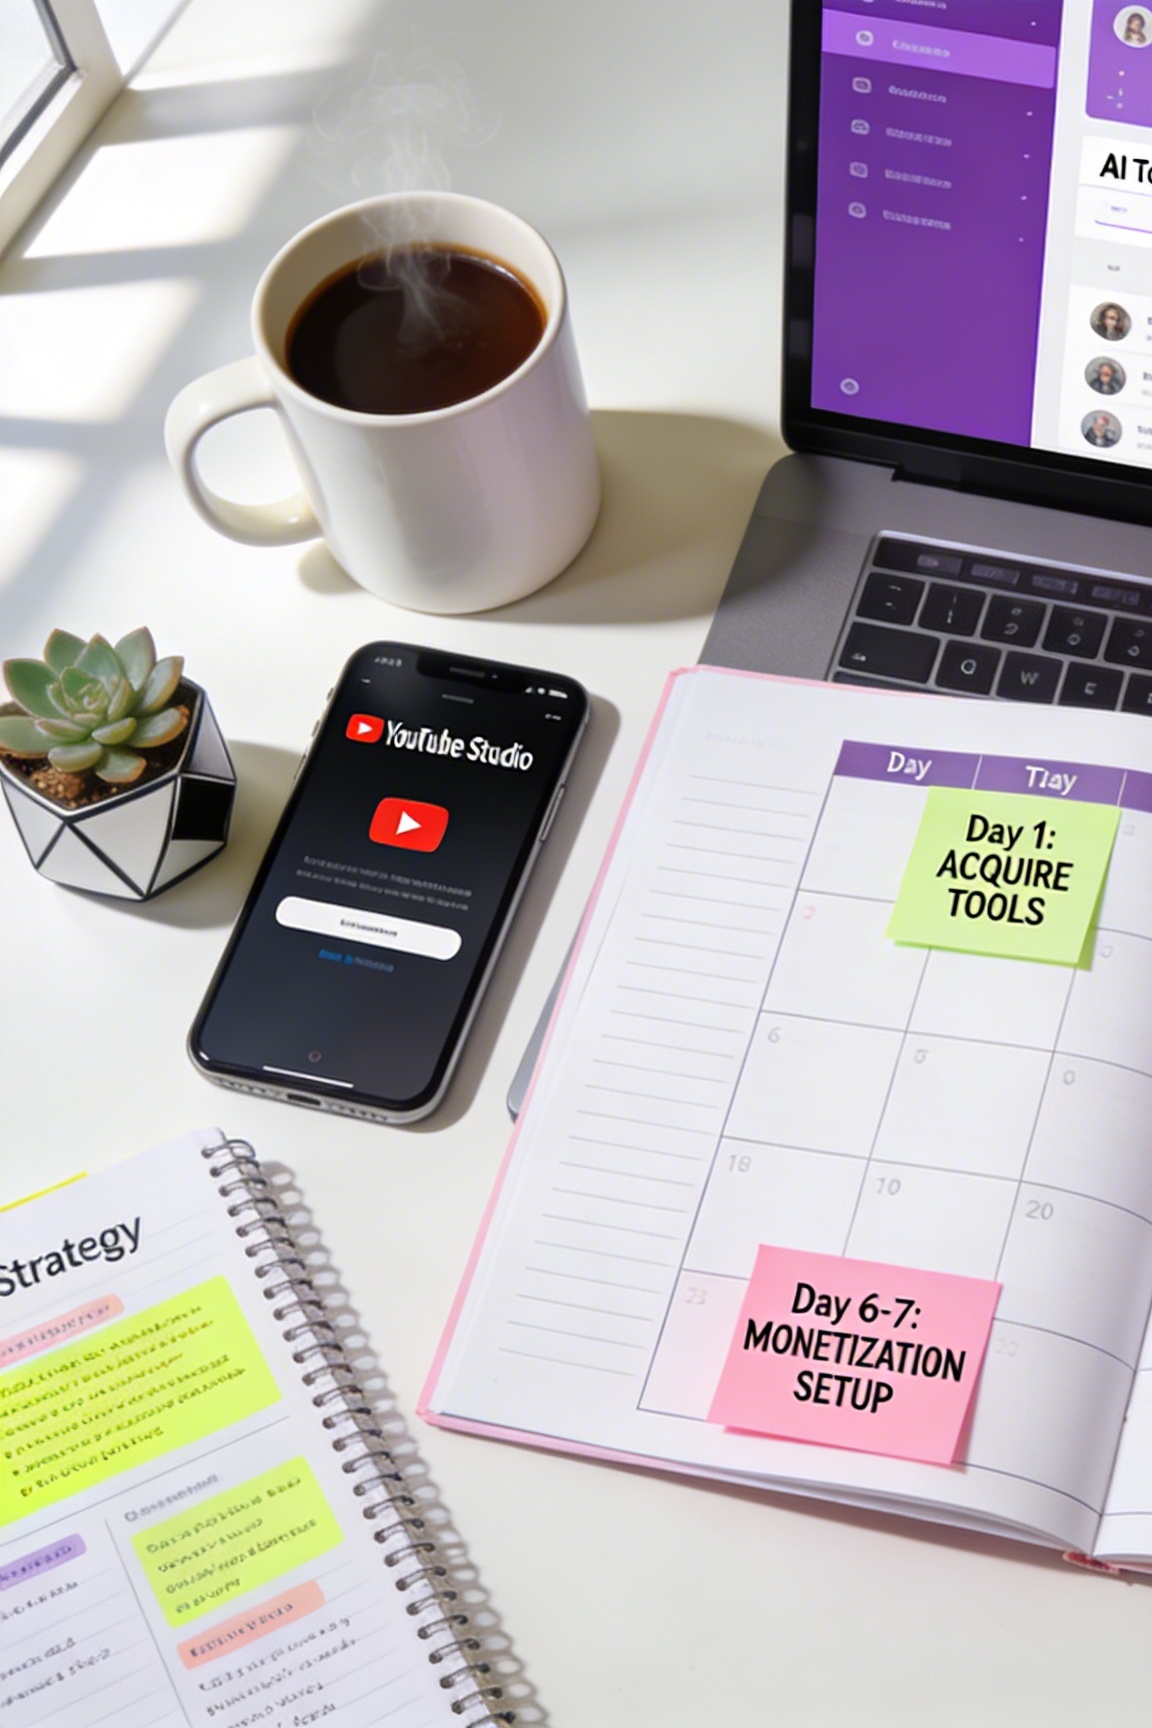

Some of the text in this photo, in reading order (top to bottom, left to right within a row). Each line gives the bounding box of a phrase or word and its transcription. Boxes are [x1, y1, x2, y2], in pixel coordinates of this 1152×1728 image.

[1099, 152, 1127, 180] AI
[385, 720, 534, 771] YouTube Studio
[887, 751, 932, 781] Day
[966, 813, 1056, 852] Day 1:
[935, 849, 1074, 892] ACQUIRE
[948, 887, 1045, 926] TOOLS
[791, 1282, 921, 1330] Day 6-7:
[743, 1317, 966, 1383] MONETIZATION
[793, 1370, 893, 1414] SETUP
